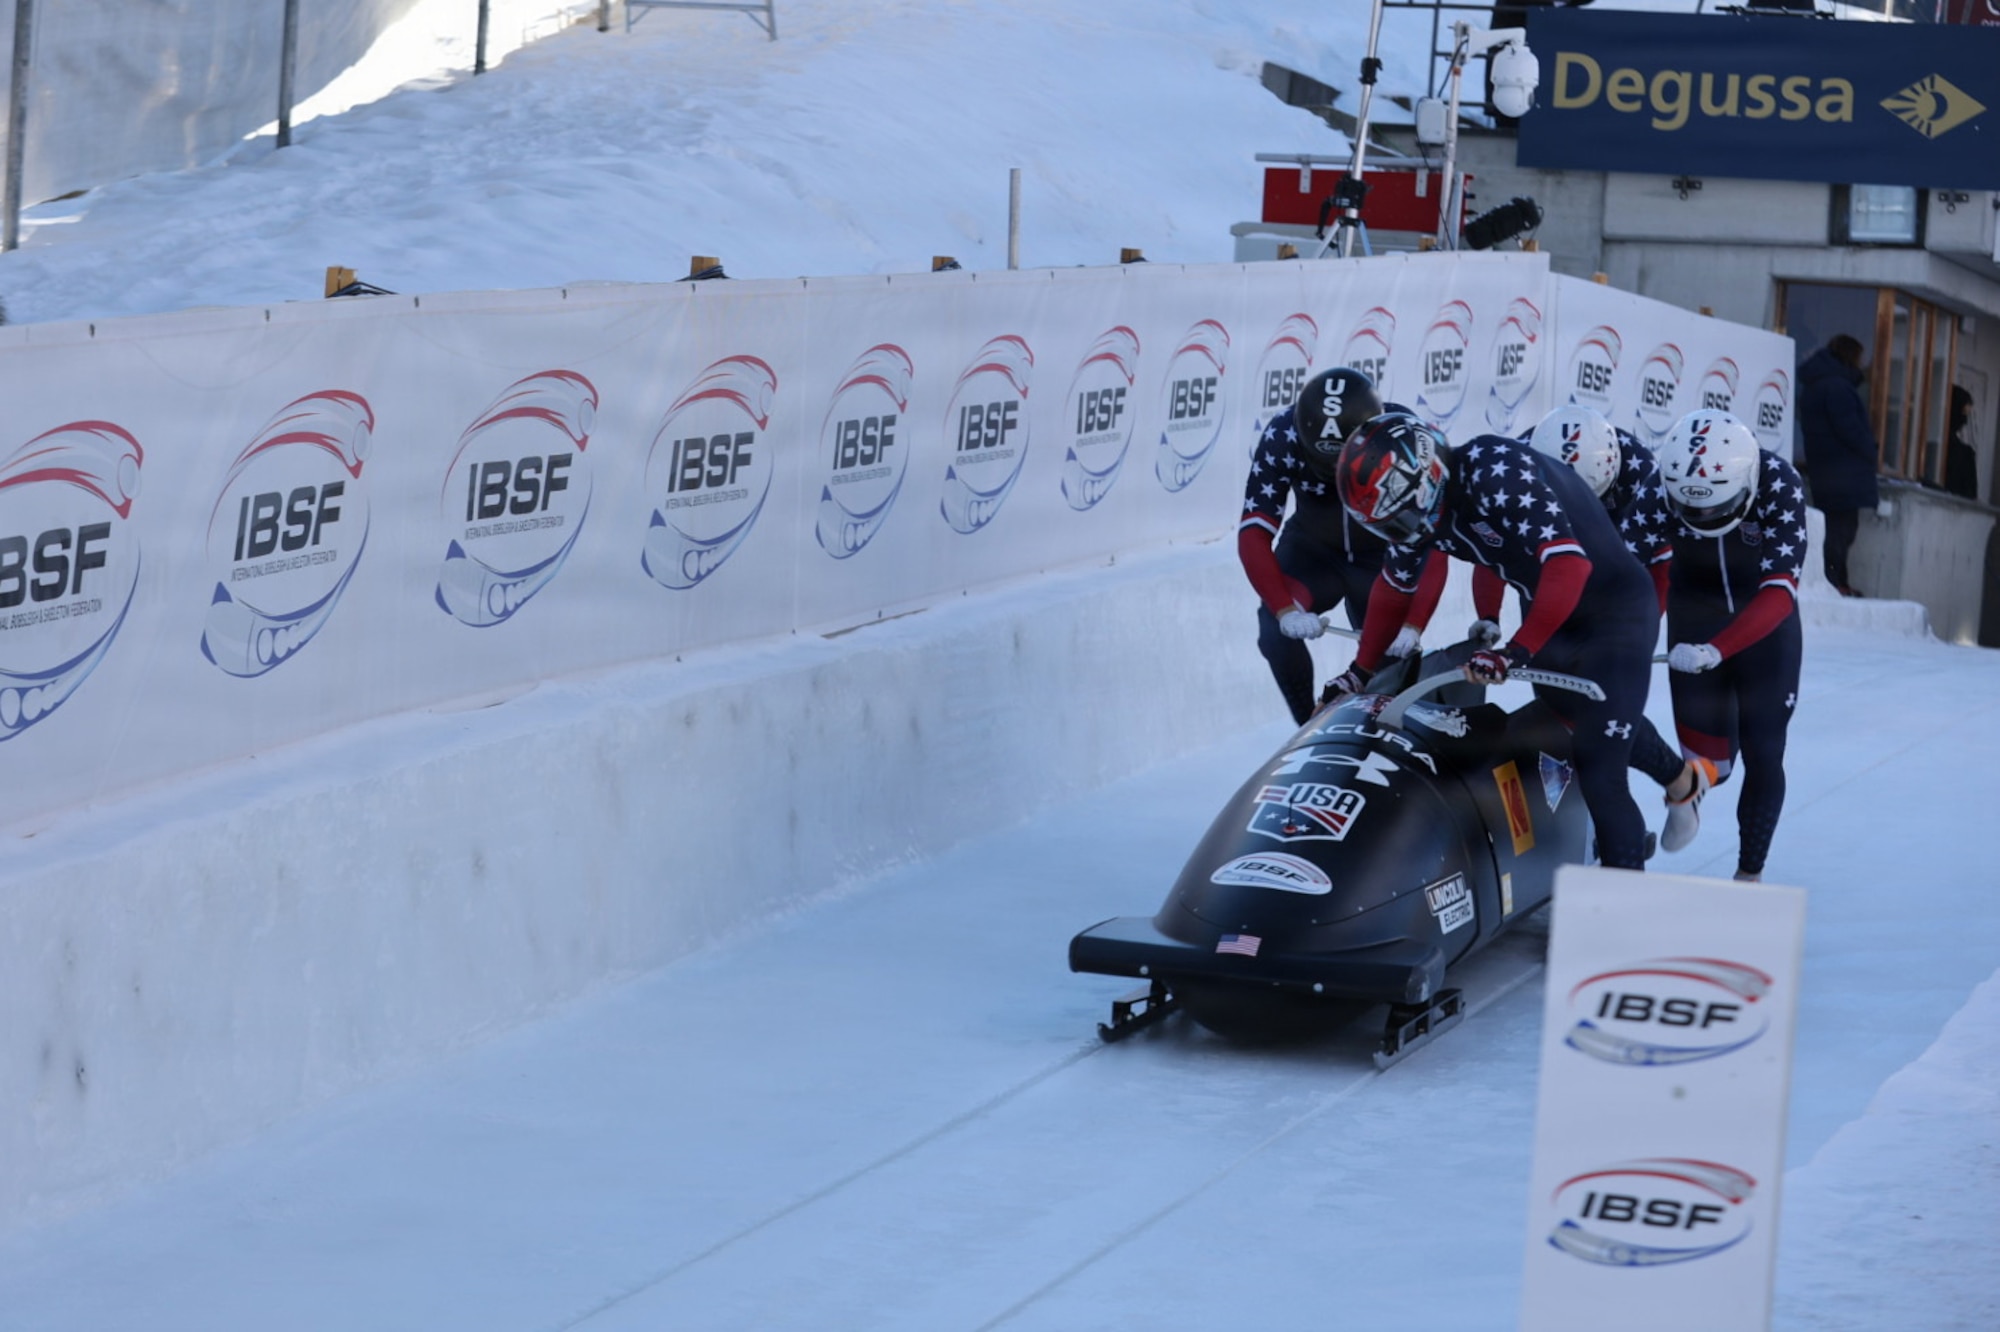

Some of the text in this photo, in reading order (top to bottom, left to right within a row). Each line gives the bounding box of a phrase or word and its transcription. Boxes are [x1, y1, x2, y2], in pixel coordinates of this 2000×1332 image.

[1553, 51, 1854, 131] Degussa
[1263, 368, 1307, 409] IBSF
[1425, 348, 1464, 386] IBSF
[1577, 361, 1613, 394] IBSF
[1077, 386, 1127, 435] IBSF
[1169, 377, 1218, 421] IBSF
[1320, 378, 1346, 439] USA
[1642, 377, 1675, 408] IBSF
[957, 401, 1019, 452] IBSF
[1757, 402, 1784, 430] IBSF
[667, 431, 754, 494] IBSF
[832, 415, 897, 471] IBSF
[1561, 423, 1581, 468] US
[1686, 420, 1711, 478] USA
[466, 452, 573, 522] IBSF
[233, 481, 345, 562] IBSF
[1304, 724, 1438, 775] ACURA
[1288, 785, 1360, 816] USA
[1235, 861, 1310, 884] IBSF
[1428, 876, 1466, 912] LINCOLN
[1443, 901, 1471, 928] ELECTRIC
[1597, 992, 1741, 1029] IBSF
[1581, 1192, 1725, 1229] IBSF
